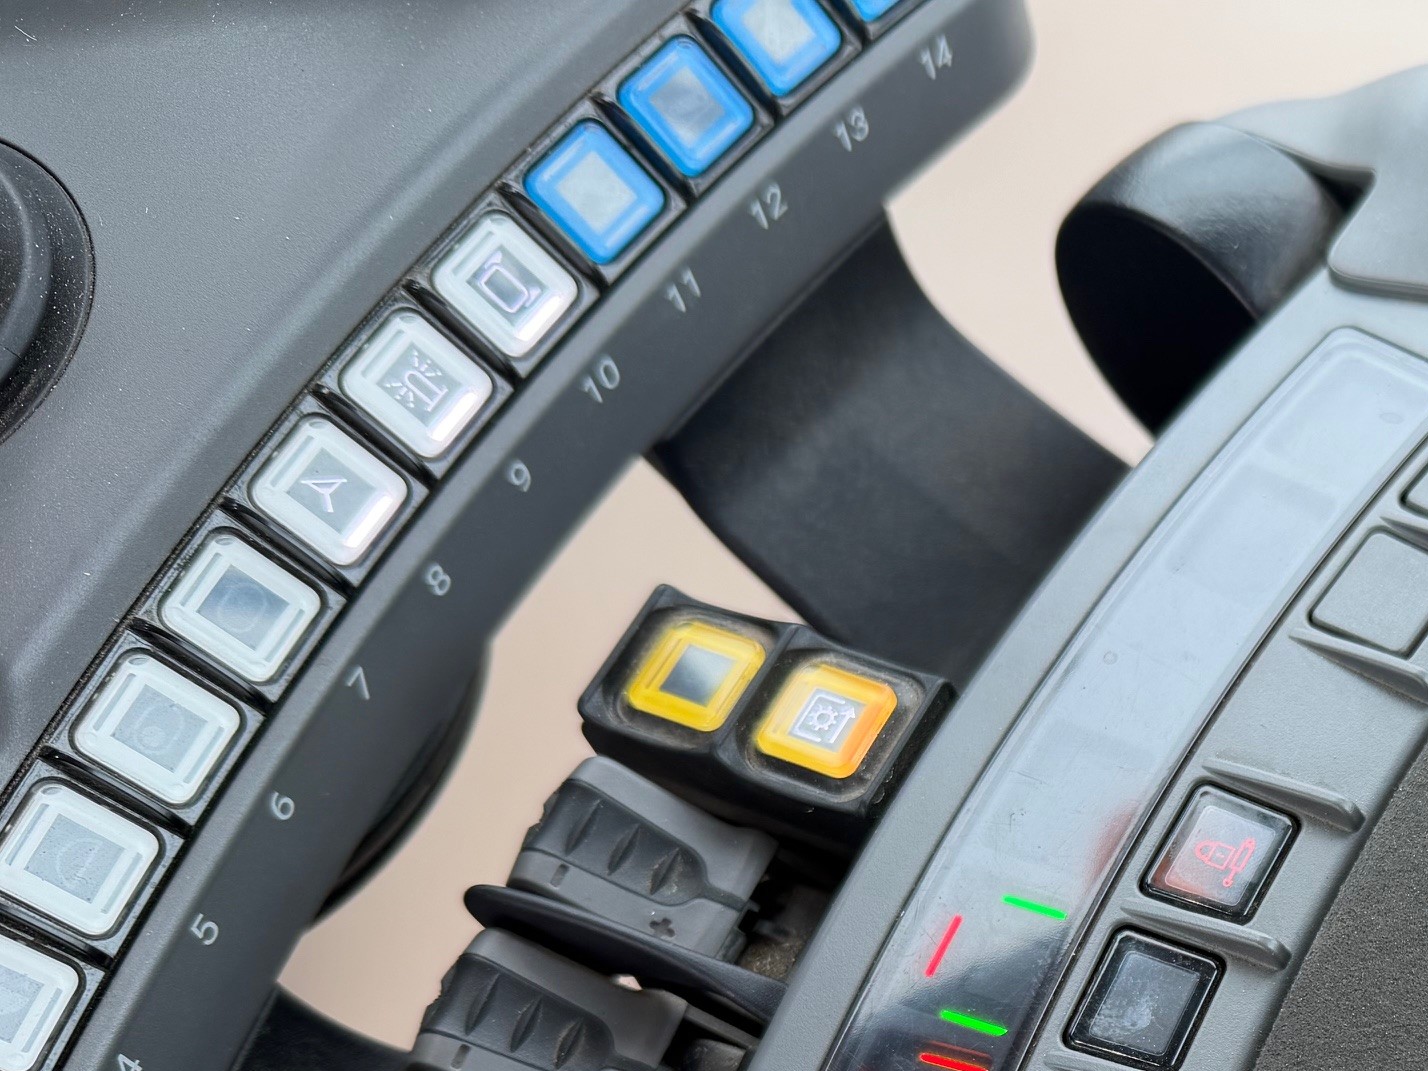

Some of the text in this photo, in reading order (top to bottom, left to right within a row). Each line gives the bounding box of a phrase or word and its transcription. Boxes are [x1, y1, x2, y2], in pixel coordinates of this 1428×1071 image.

[921, 36, 952, 79] 14
[836, 108, 869, 151] 13
[751, 184, 788, 229] 12
[667, 268, 701, 312] 11
[583, 356, 620, 403] 10
[508, 460, 531, 492] 9
[425, 563, 451, 596] 8
[346, 665, 370, 700] 7
[270, 791, 296, 820] 6
[191, 913, 219, 946] 5
